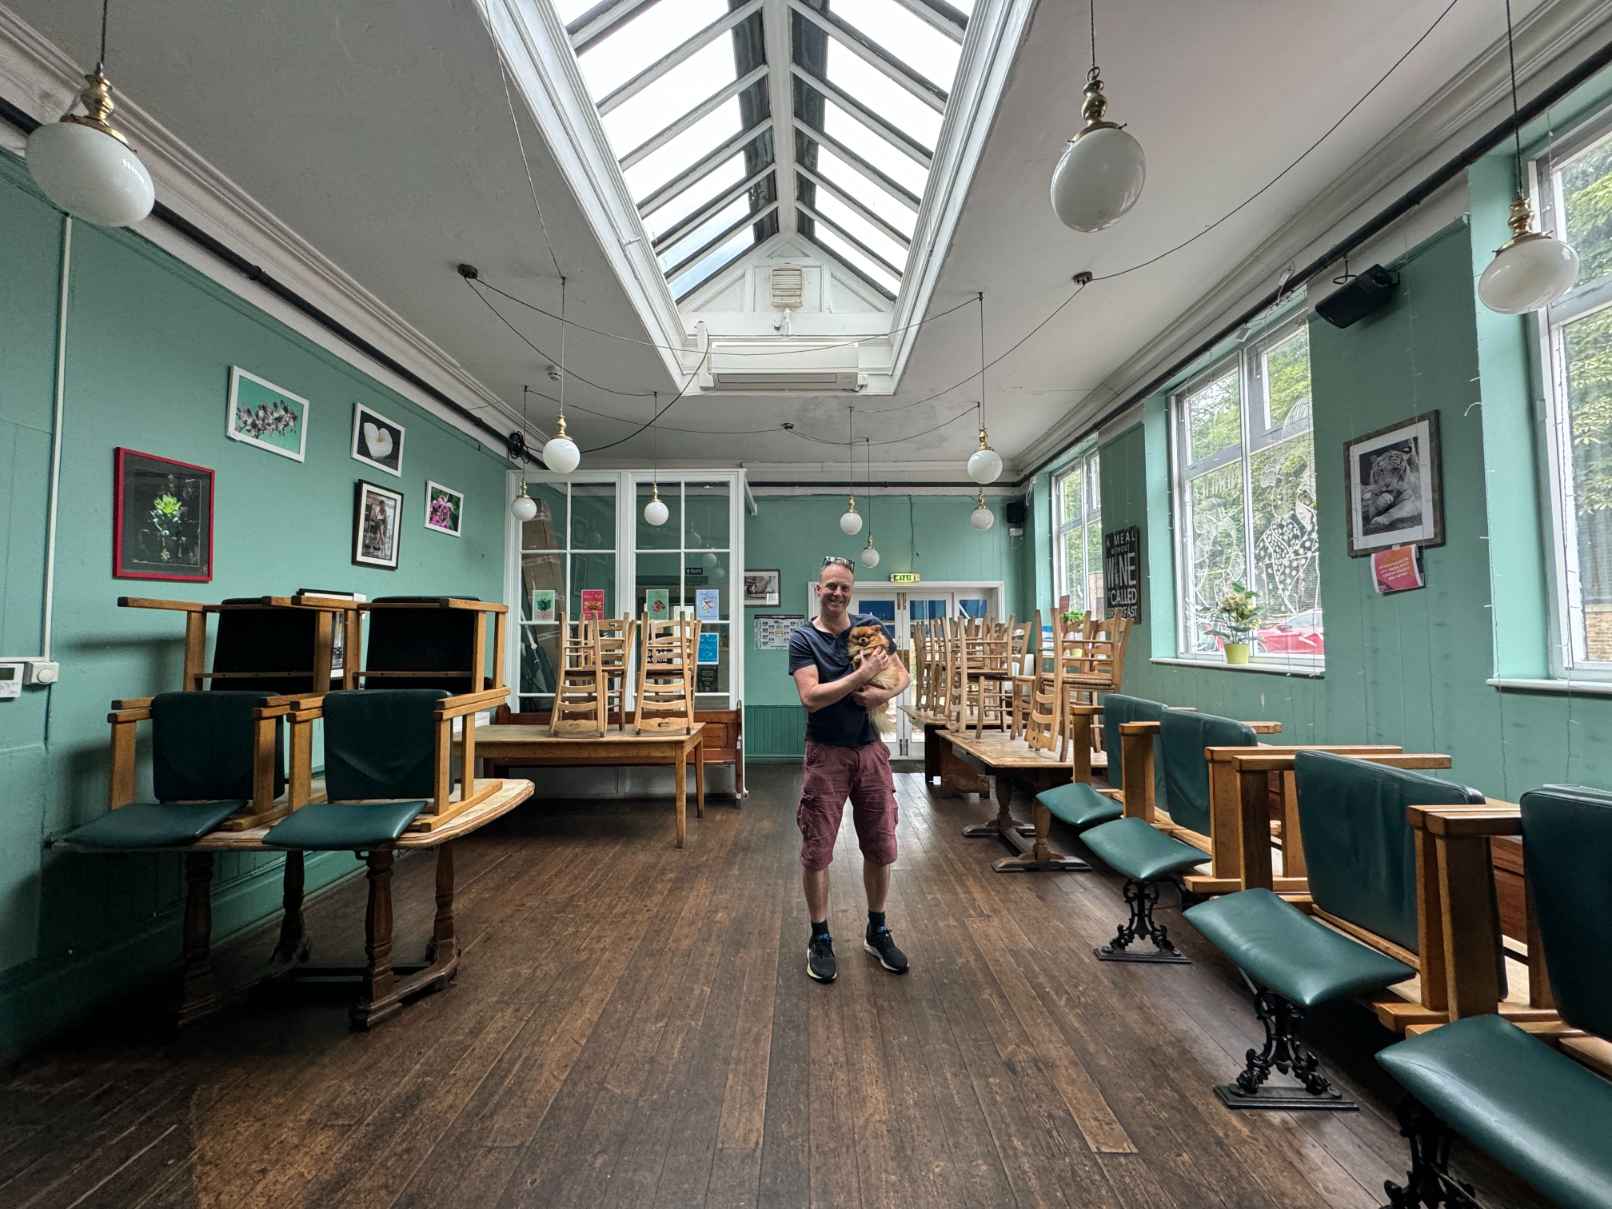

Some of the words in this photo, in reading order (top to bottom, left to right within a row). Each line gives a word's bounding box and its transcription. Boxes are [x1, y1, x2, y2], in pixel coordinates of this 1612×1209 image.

[1114, 530, 1135, 545] MEAL
[1106, 552, 1136, 588] WINE
[1111, 588, 1137, 605] CALLED
